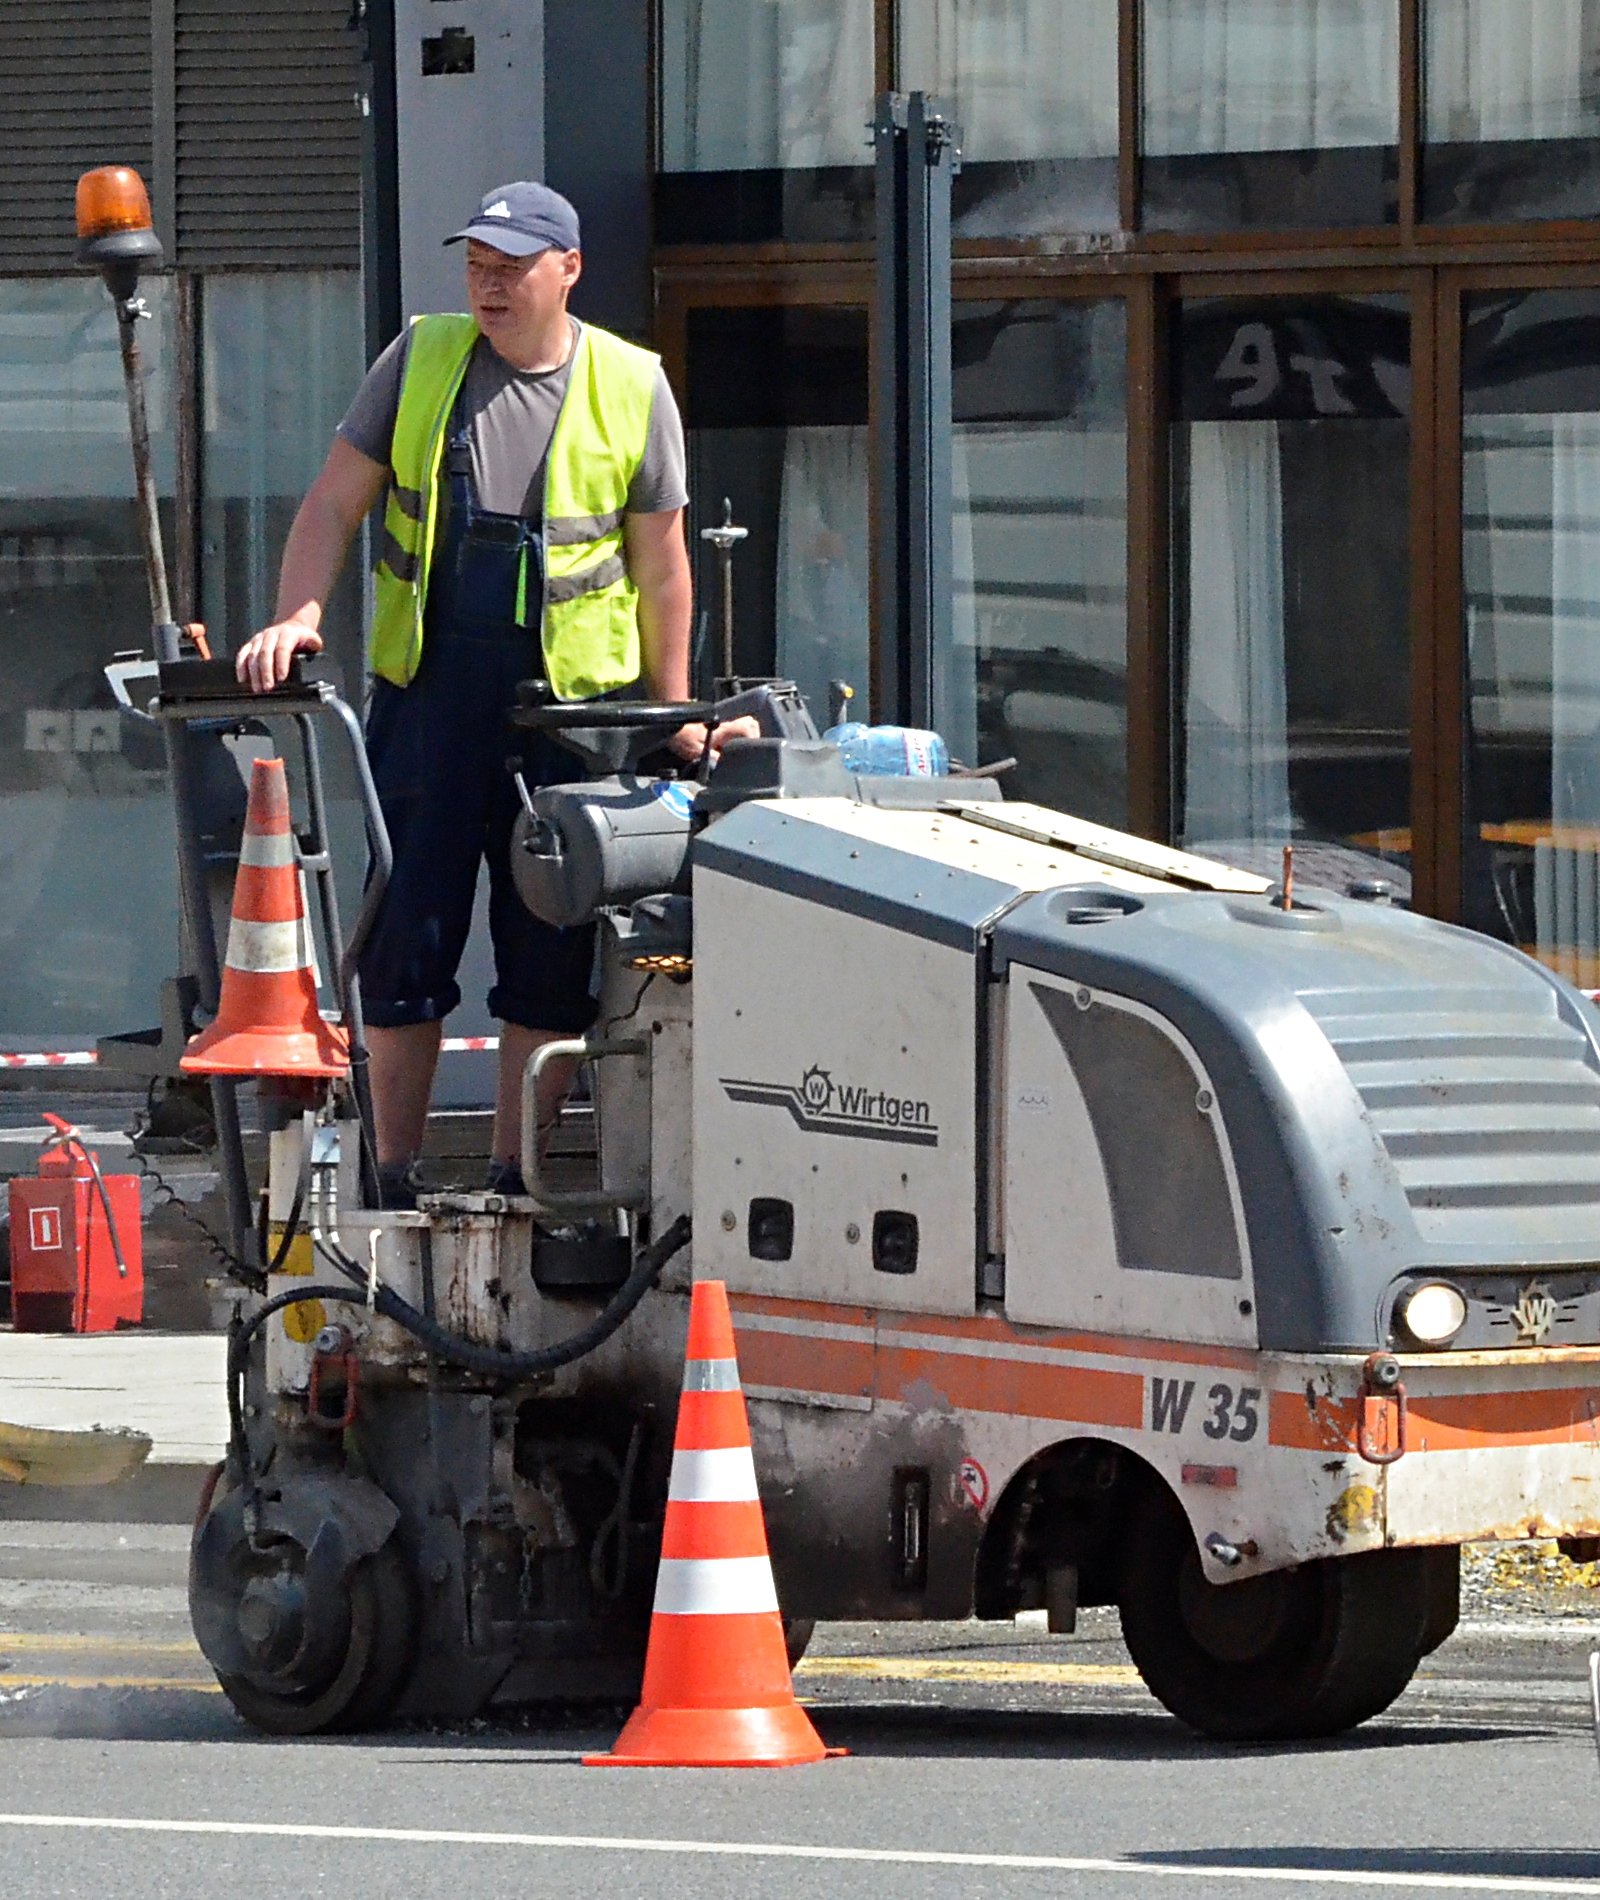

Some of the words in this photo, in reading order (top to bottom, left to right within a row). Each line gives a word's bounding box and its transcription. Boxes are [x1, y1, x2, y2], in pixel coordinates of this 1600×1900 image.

[838, 1084, 930, 1126] Wirtgen
[1151, 1377, 1196, 1433] W
[1203, 1383, 1262, 1442] 35
